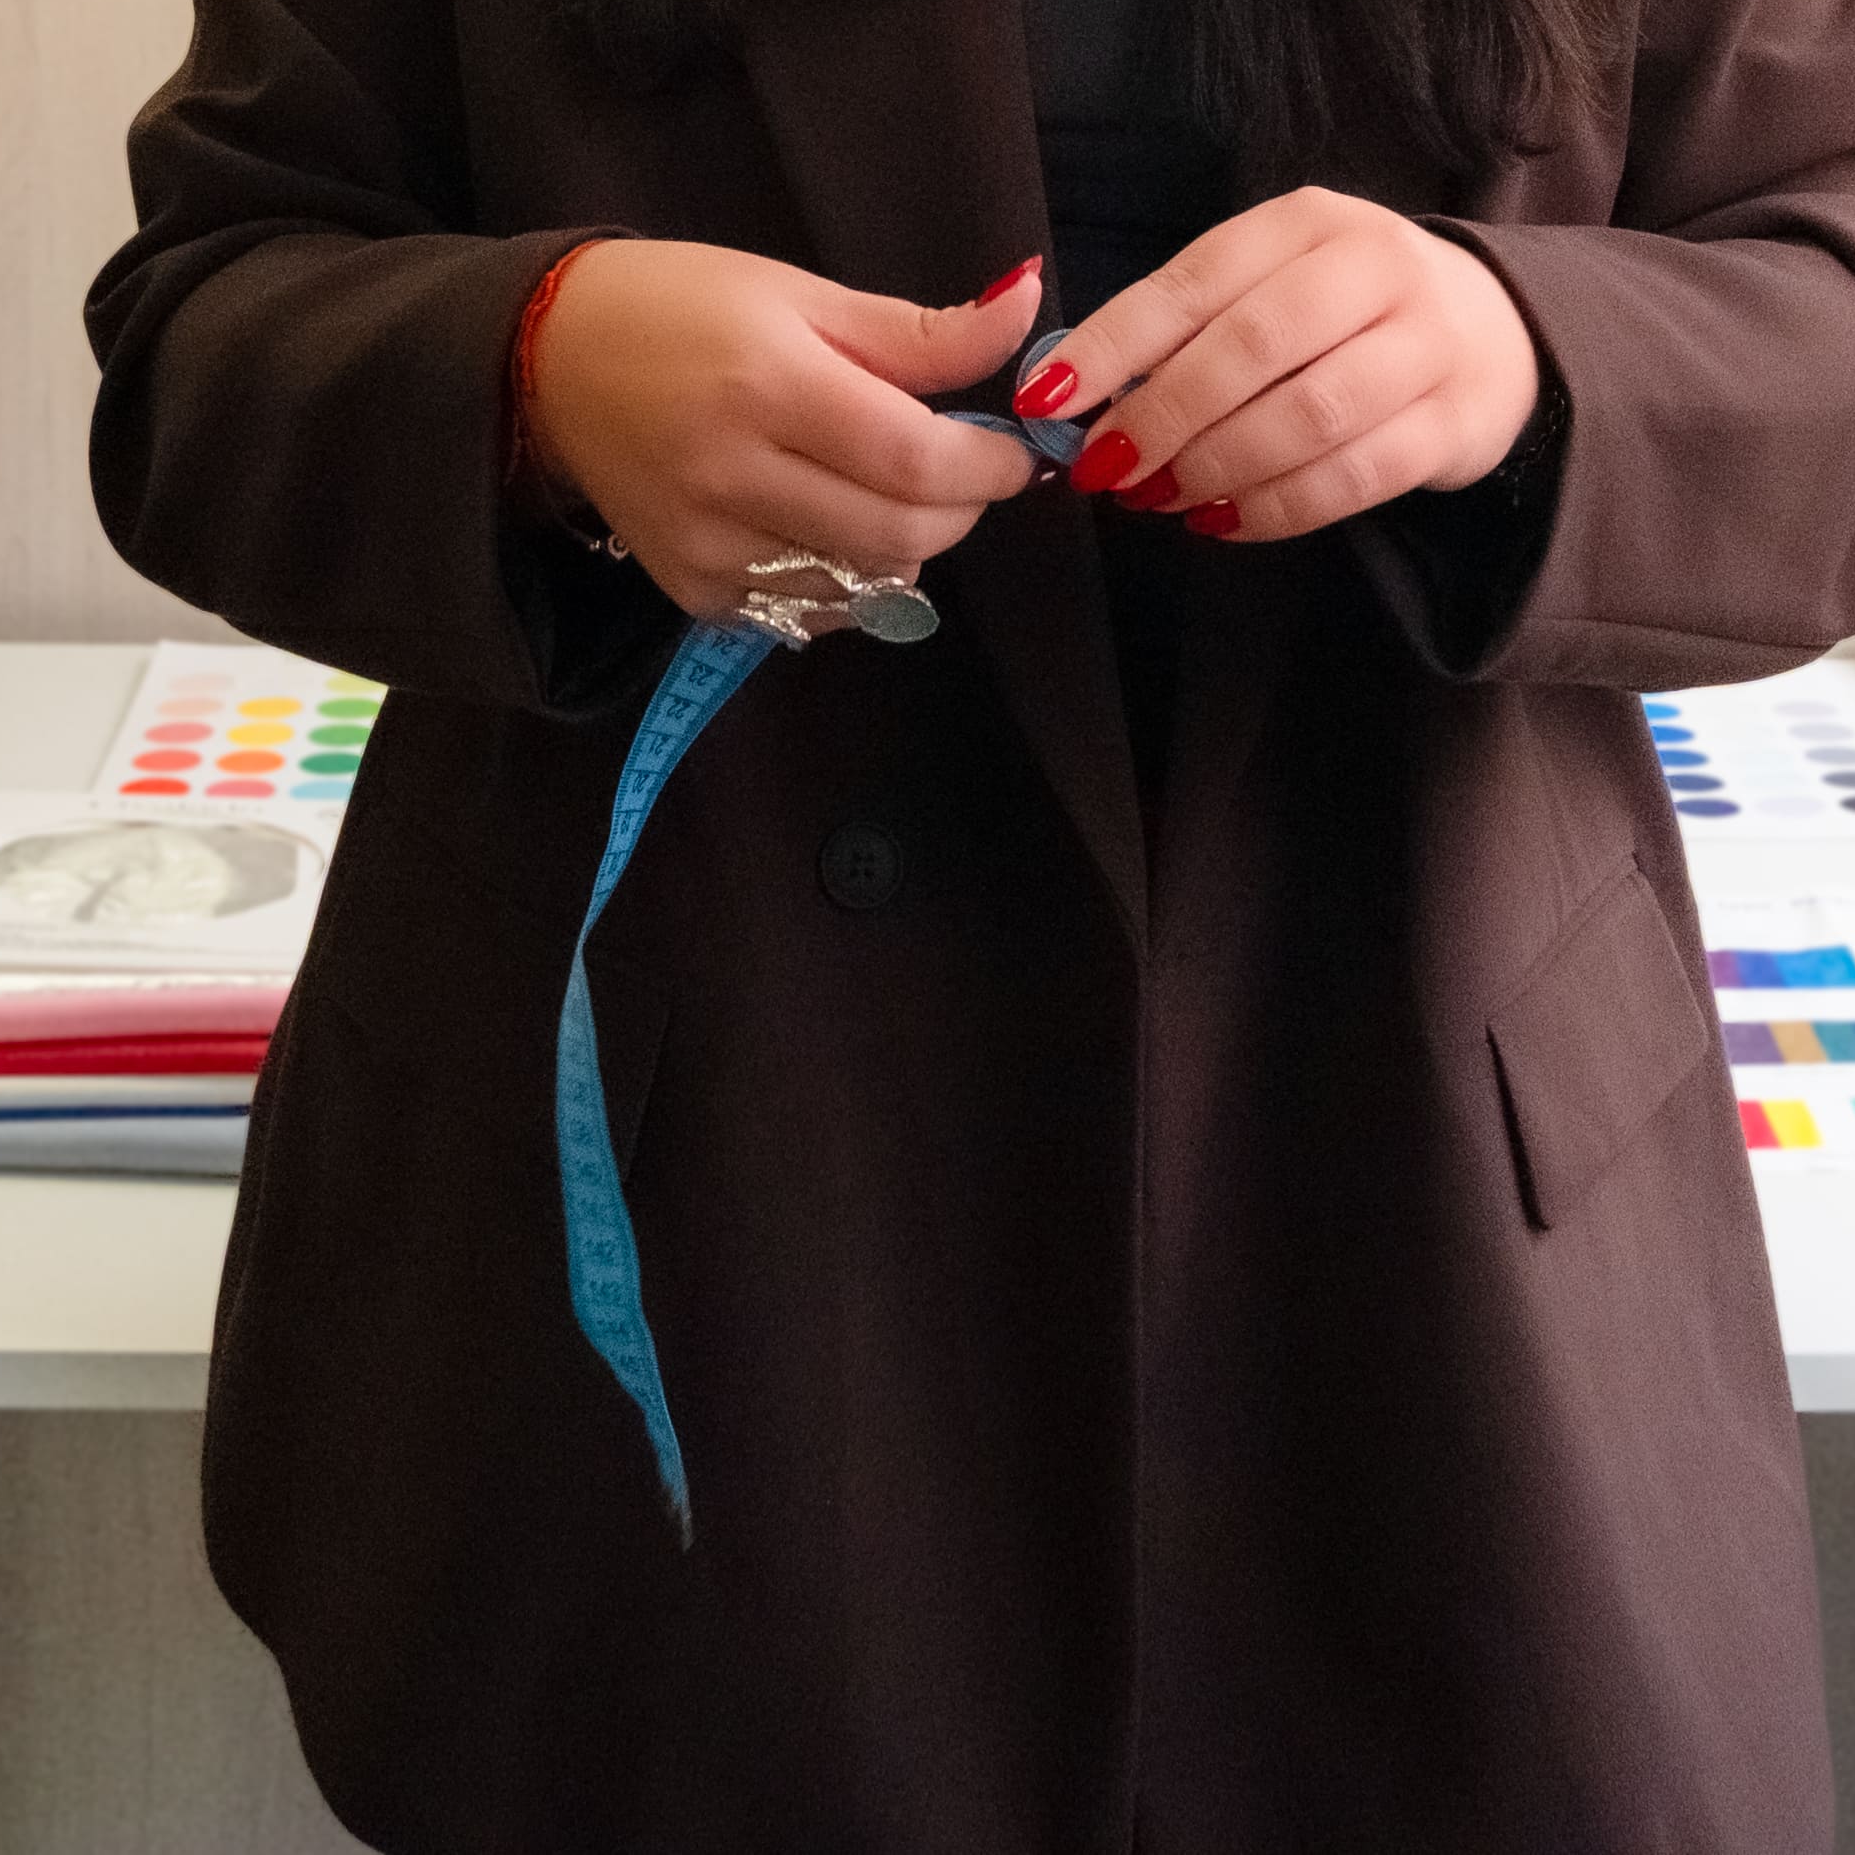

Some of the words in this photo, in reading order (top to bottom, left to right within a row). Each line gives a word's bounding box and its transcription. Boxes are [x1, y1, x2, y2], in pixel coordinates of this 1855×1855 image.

[688, 664, 713, 686] 23
[667, 696, 691, 719] 22
[647, 732, 670, 755] 21
